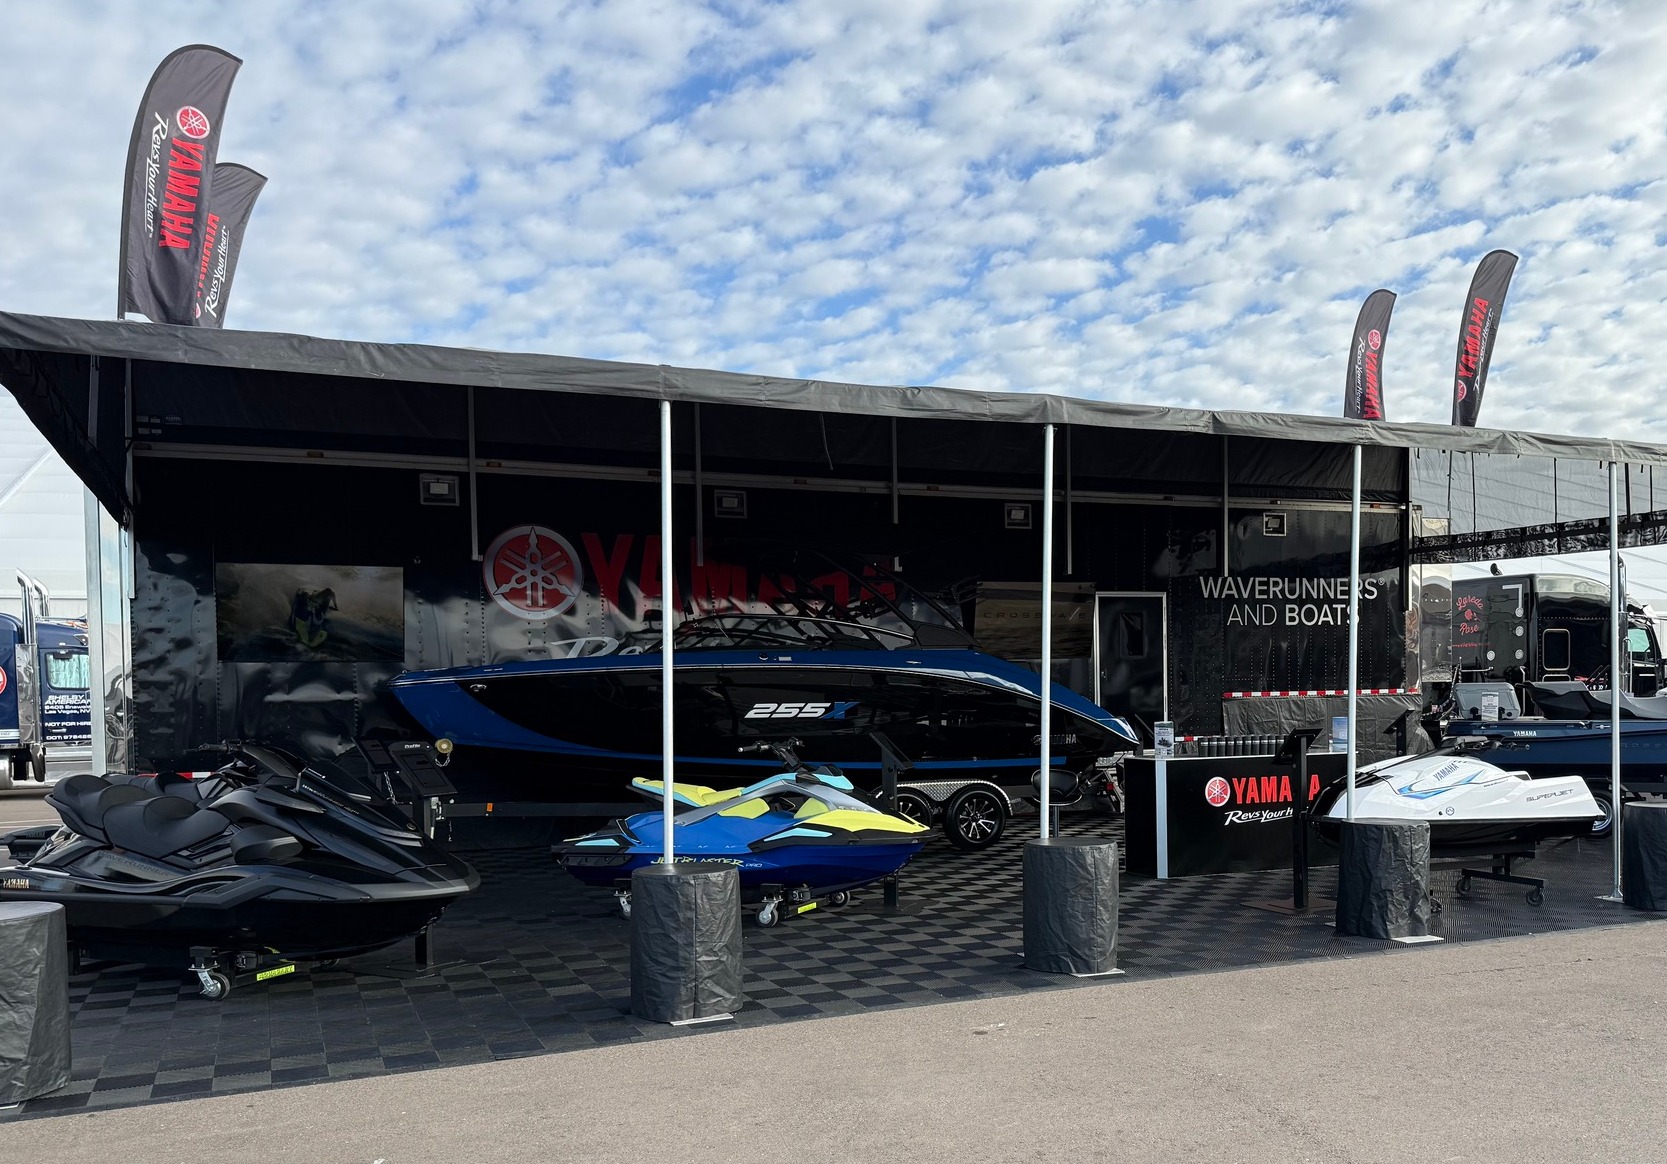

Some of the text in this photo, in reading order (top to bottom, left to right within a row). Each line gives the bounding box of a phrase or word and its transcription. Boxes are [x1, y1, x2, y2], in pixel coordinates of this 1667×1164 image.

[152, 111, 169, 160] Revs
[159, 137, 204, 249] YAMAHA
[205, 278, 220, 318] Revs
[214, 254, 226, 283] Your
[1459, 296, 1489, 377] YAMAHA
[1363, 351, 1381, 418] YAMAHA
[983, 611, 1087, 619] CROSSAE
[1227, 604, 1278, 626] AND
[1433, 762, 1460, 782] YAMAHA
[1232, 774, 1320, 805] YAMAA
[1224, 809, 1261, 826] Revs
[1260, 809, 1287, 823] Your
[102, 852, 170, 877] AVERUNNER
[3, 878, 29, 889] YAMAHA
